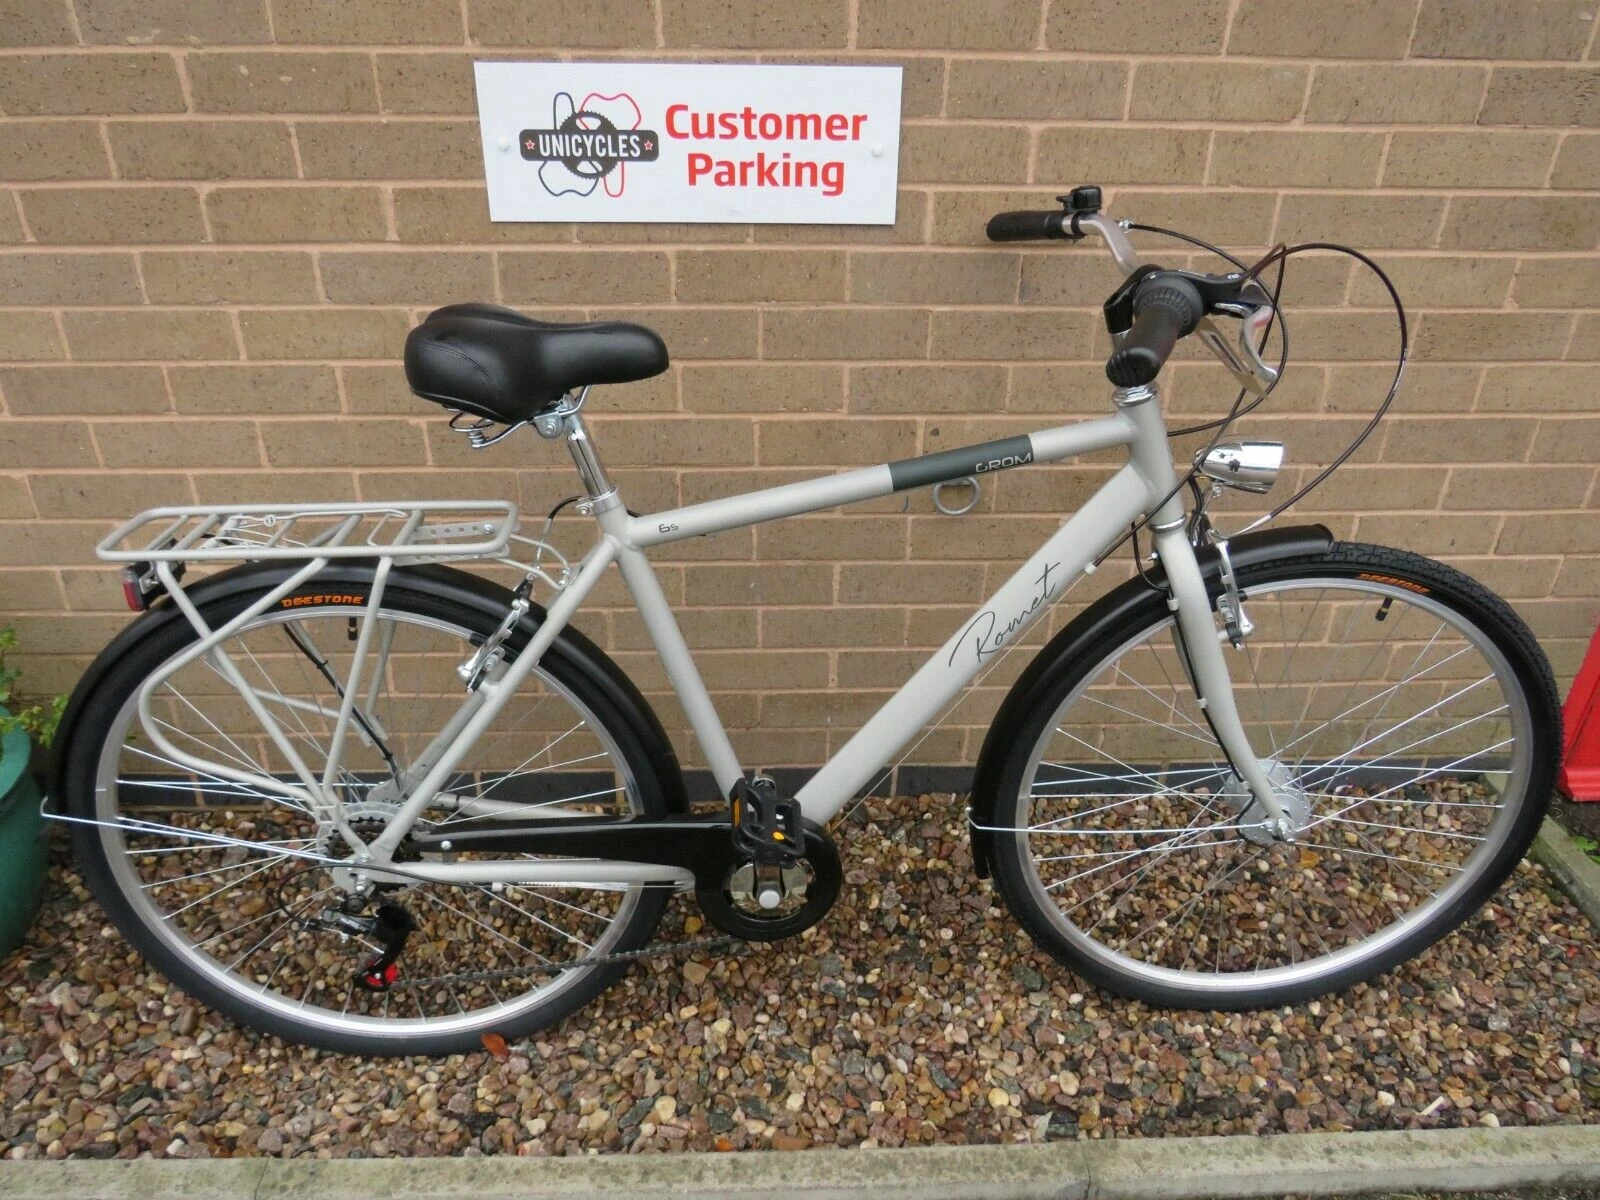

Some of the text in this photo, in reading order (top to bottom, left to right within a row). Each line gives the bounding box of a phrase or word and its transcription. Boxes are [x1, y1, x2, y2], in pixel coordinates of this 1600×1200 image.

[665, 104, 868, 141] Customer
[538, 134, 641, 159] UNICYCLES
[687, 153, 845, 196] Parking
[281, 595, 364, 608] DEESTONE
[948, 562, 1061, 667] Romet
